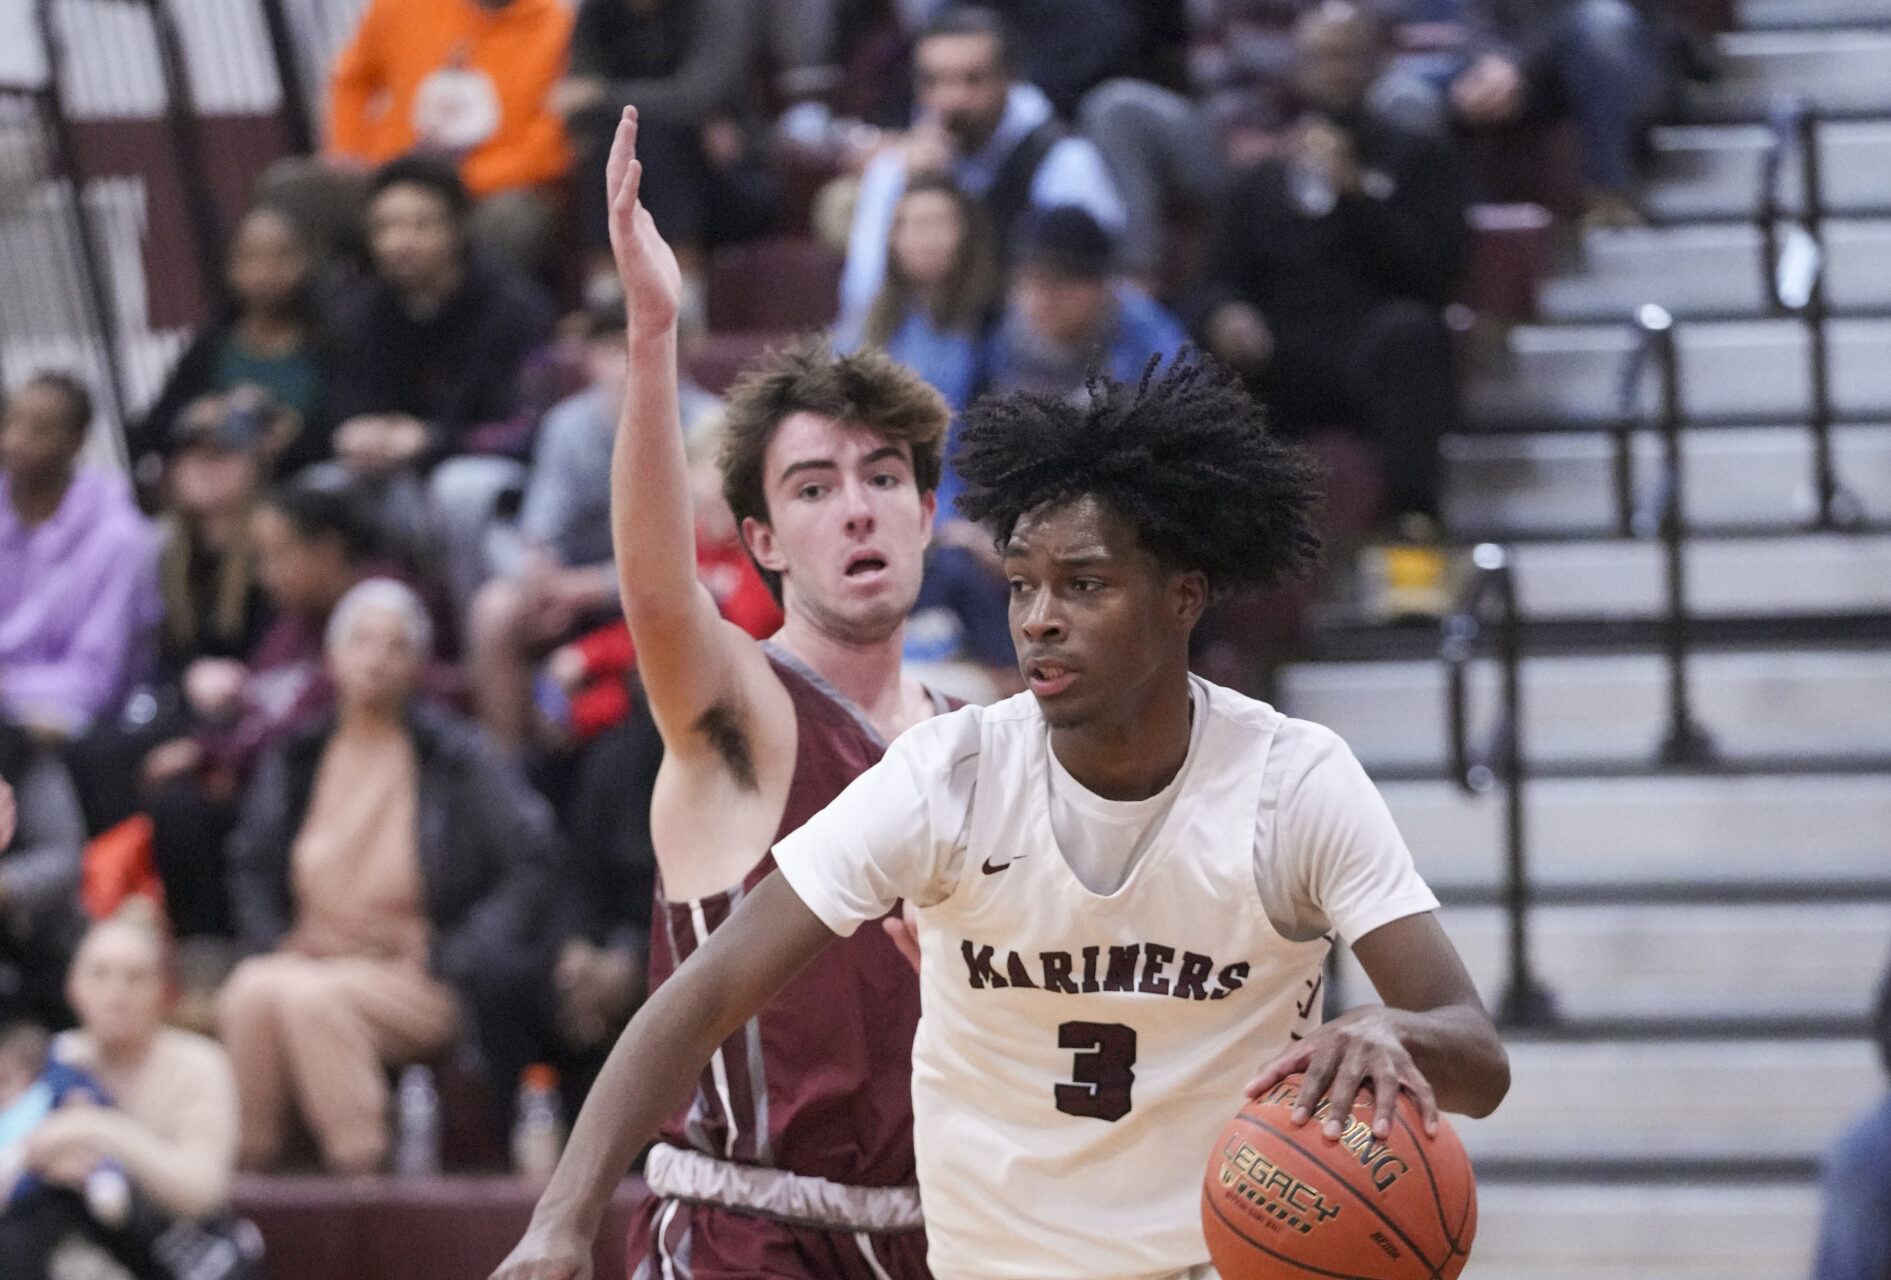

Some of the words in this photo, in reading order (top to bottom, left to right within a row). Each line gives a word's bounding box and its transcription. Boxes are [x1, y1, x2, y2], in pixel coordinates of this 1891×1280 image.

[960, 939, 1250, 1001] MARINERS
[1054, 1020, 1137, 1123] 3
[1223, 1131, 1341, 1222] LEGACY
